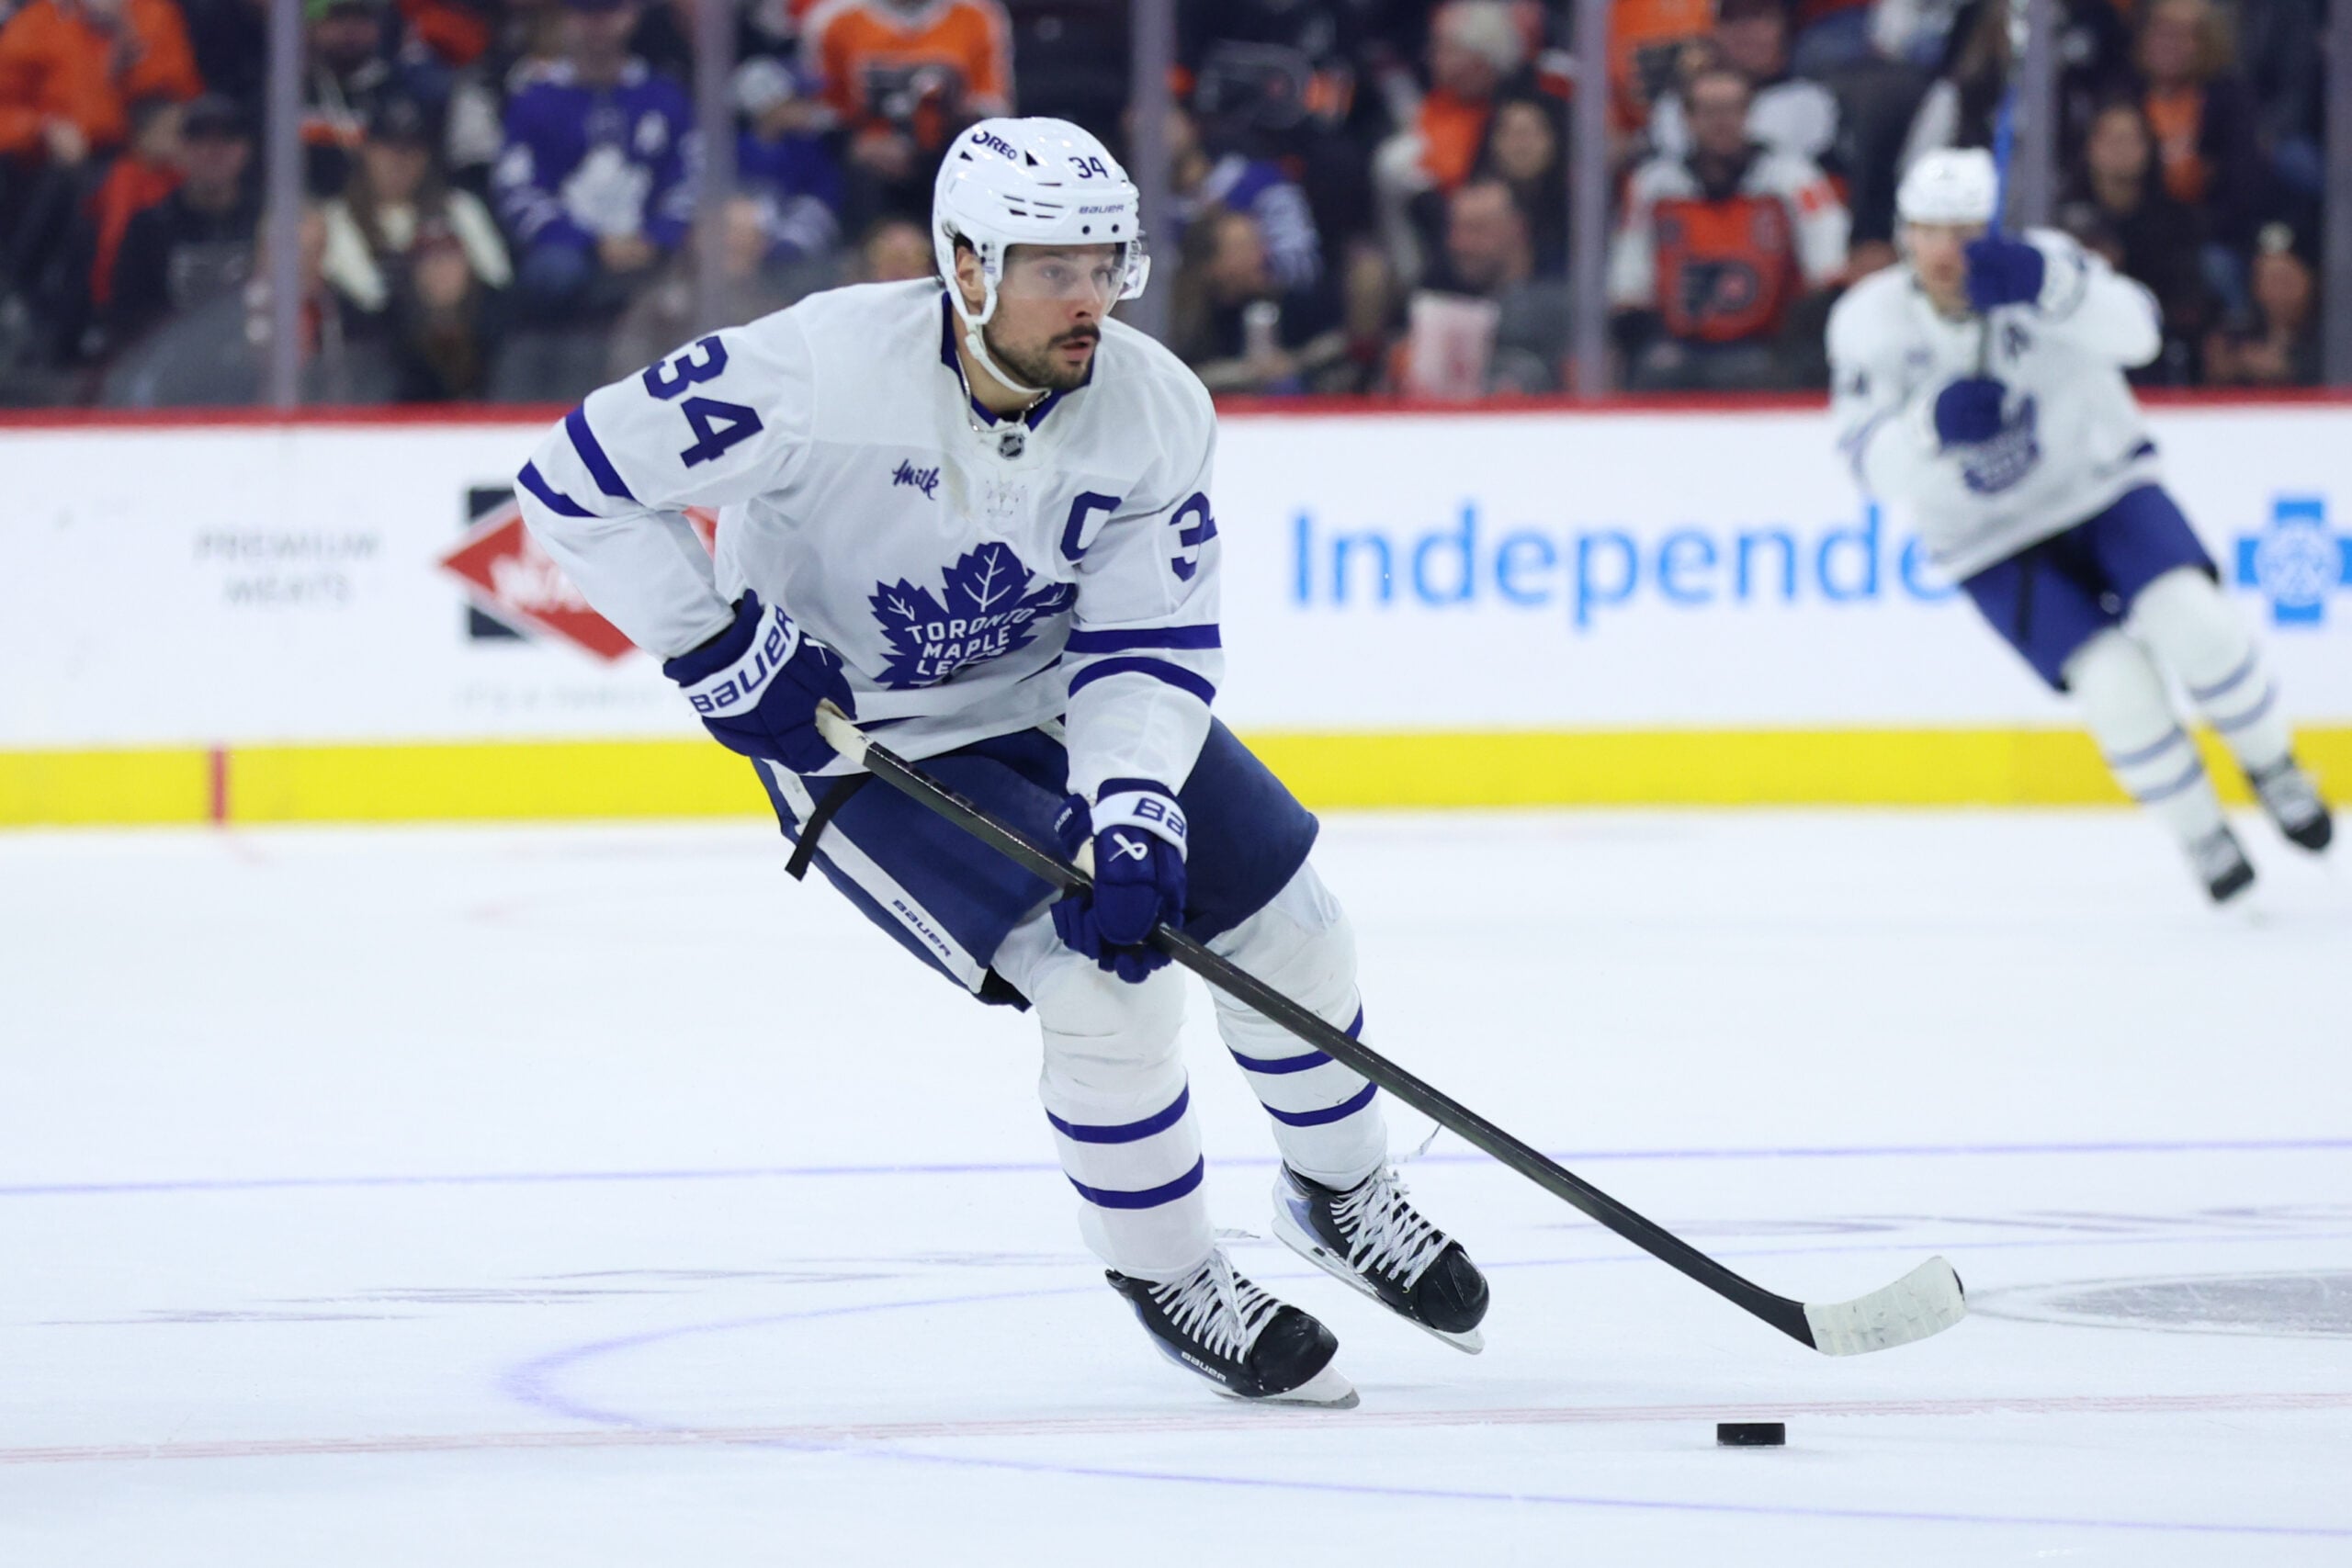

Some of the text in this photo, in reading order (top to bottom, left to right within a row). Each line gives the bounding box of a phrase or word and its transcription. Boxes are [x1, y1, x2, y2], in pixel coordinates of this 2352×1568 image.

[971, 130, 1017, 160] OREO
[1069, 156, 1109, 179] 34
[642, 335, 770, 468] 34
[1060, 491, 1122, 561] C
[904, 607, 1036, 644] TORONTO
[922, 625, 1011, 660] MAPLE
